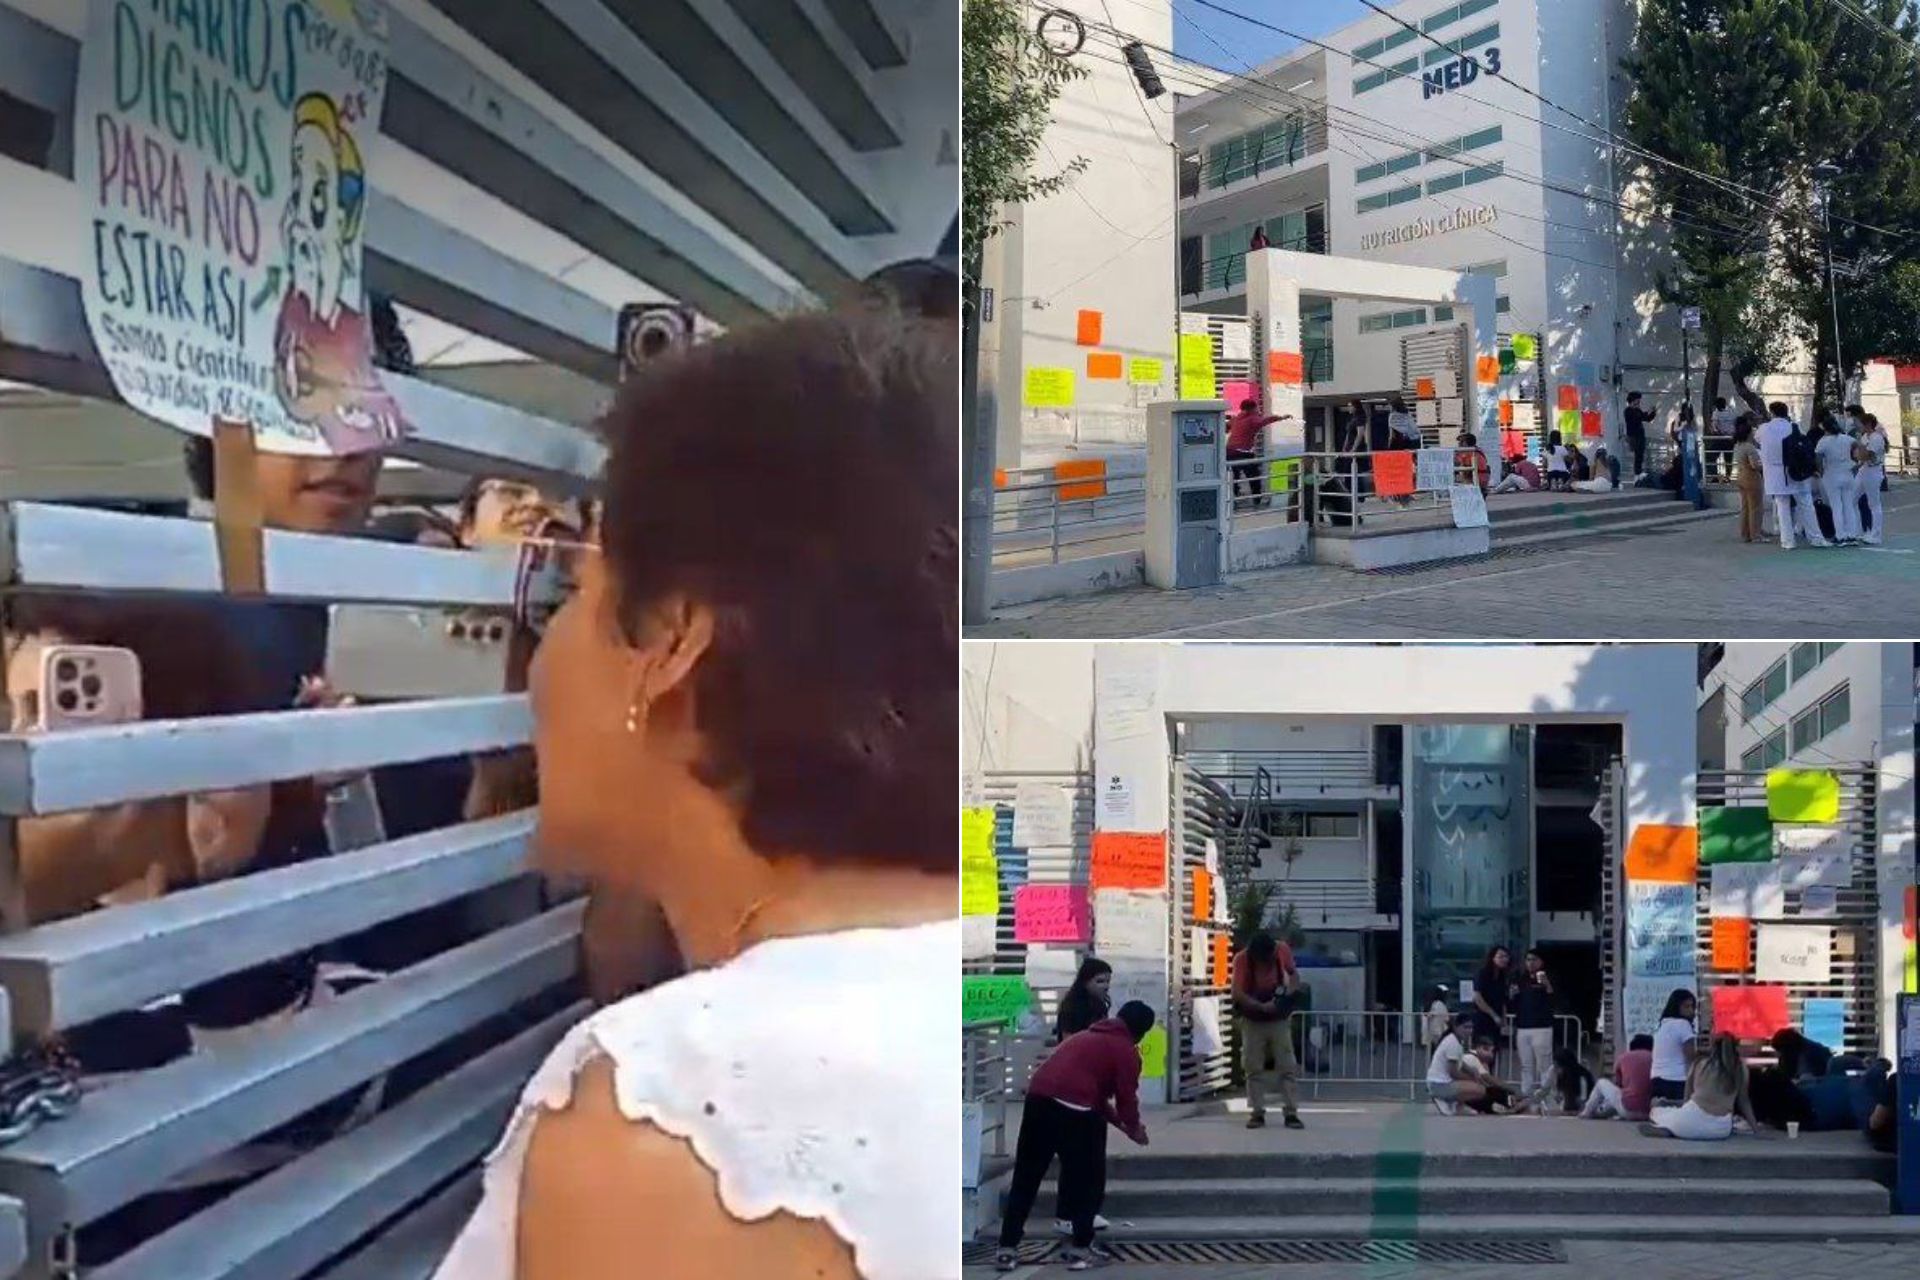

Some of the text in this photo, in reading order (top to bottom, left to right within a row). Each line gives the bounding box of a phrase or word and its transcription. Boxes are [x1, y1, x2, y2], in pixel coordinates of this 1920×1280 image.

[114, 1, 273, 198] DIGNOS
[1422, 47, 1501, 100] MED 3
[97, 113, 260, 267] PARA NO
[1360, 204, 1499, 250] NUTRICIÓN CLÍNICA
[93, 219, 246, 348] ESTAR ASI
